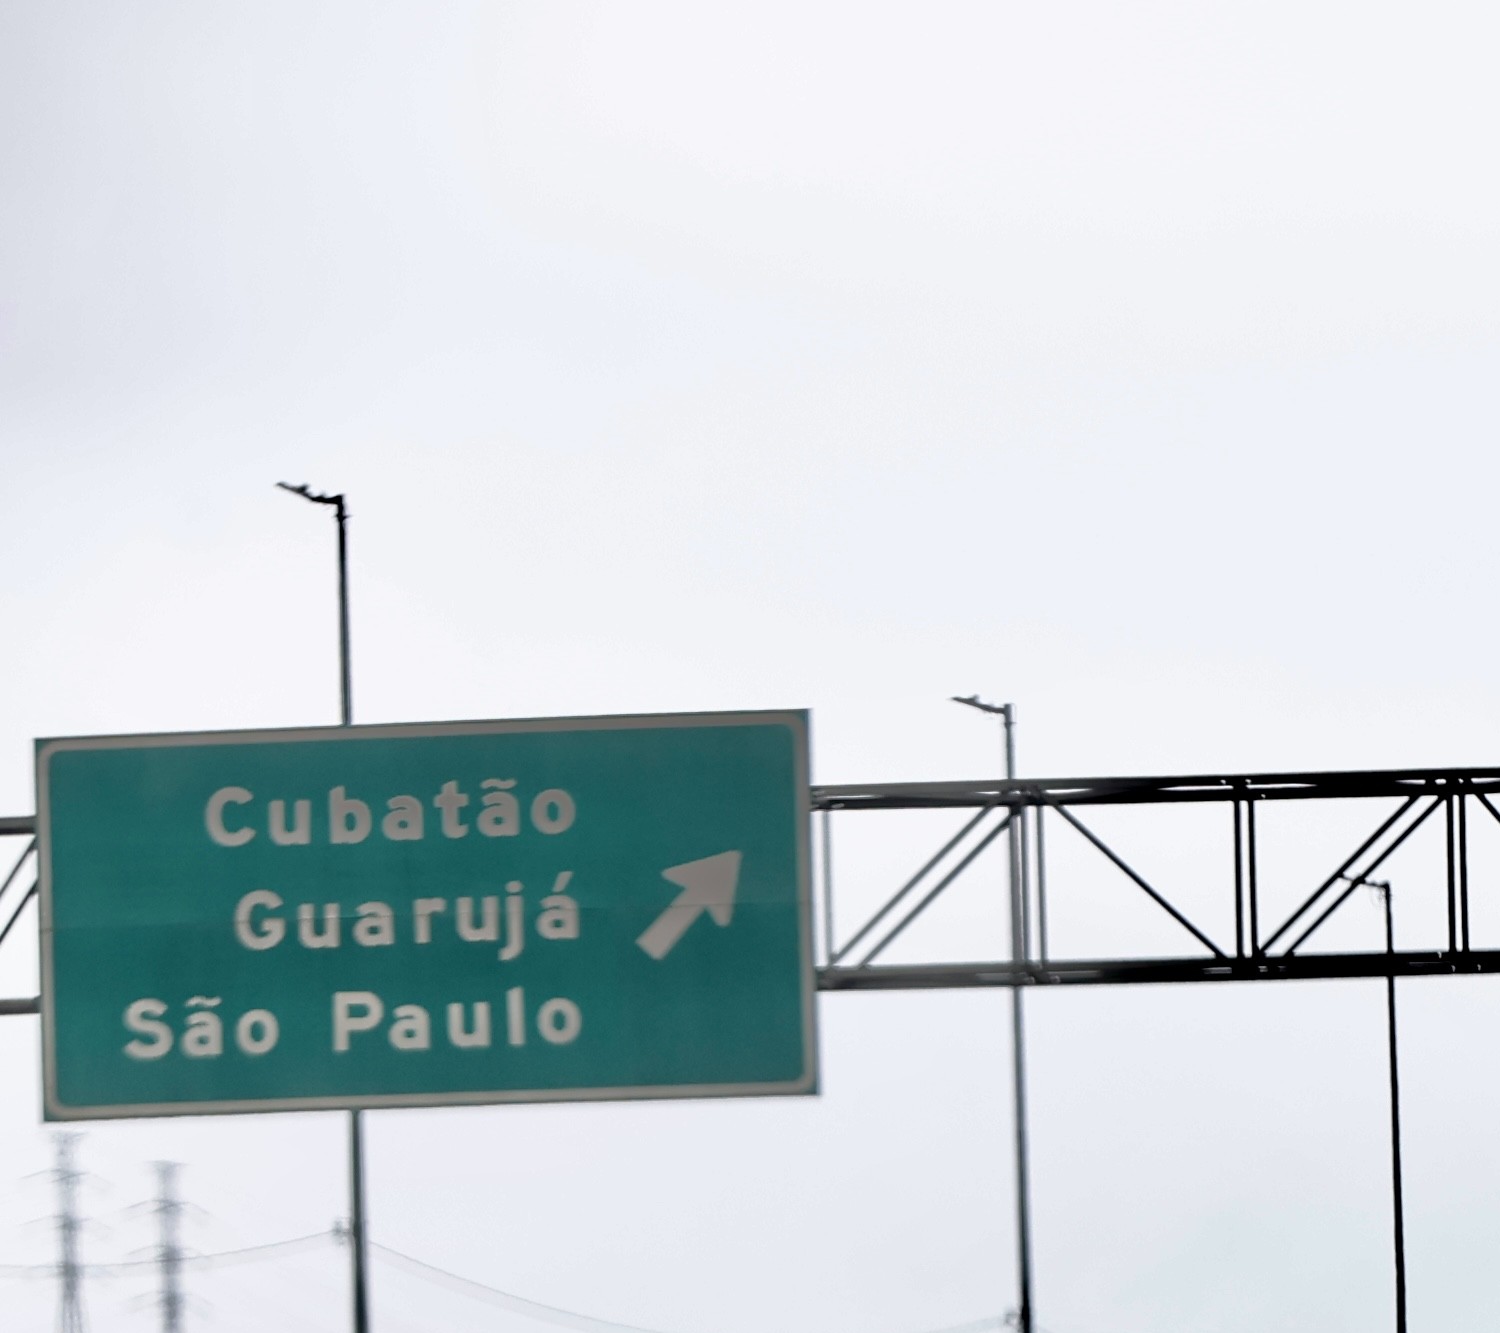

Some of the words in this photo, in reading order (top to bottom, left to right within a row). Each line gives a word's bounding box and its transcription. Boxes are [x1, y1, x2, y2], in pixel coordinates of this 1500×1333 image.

[204, 778, 578, 849] Cubatão
[235, 871, 582, 961] Guarujá
[124, 997, 281, 1062] São
[332, 987, 584, 1053] Paulo
